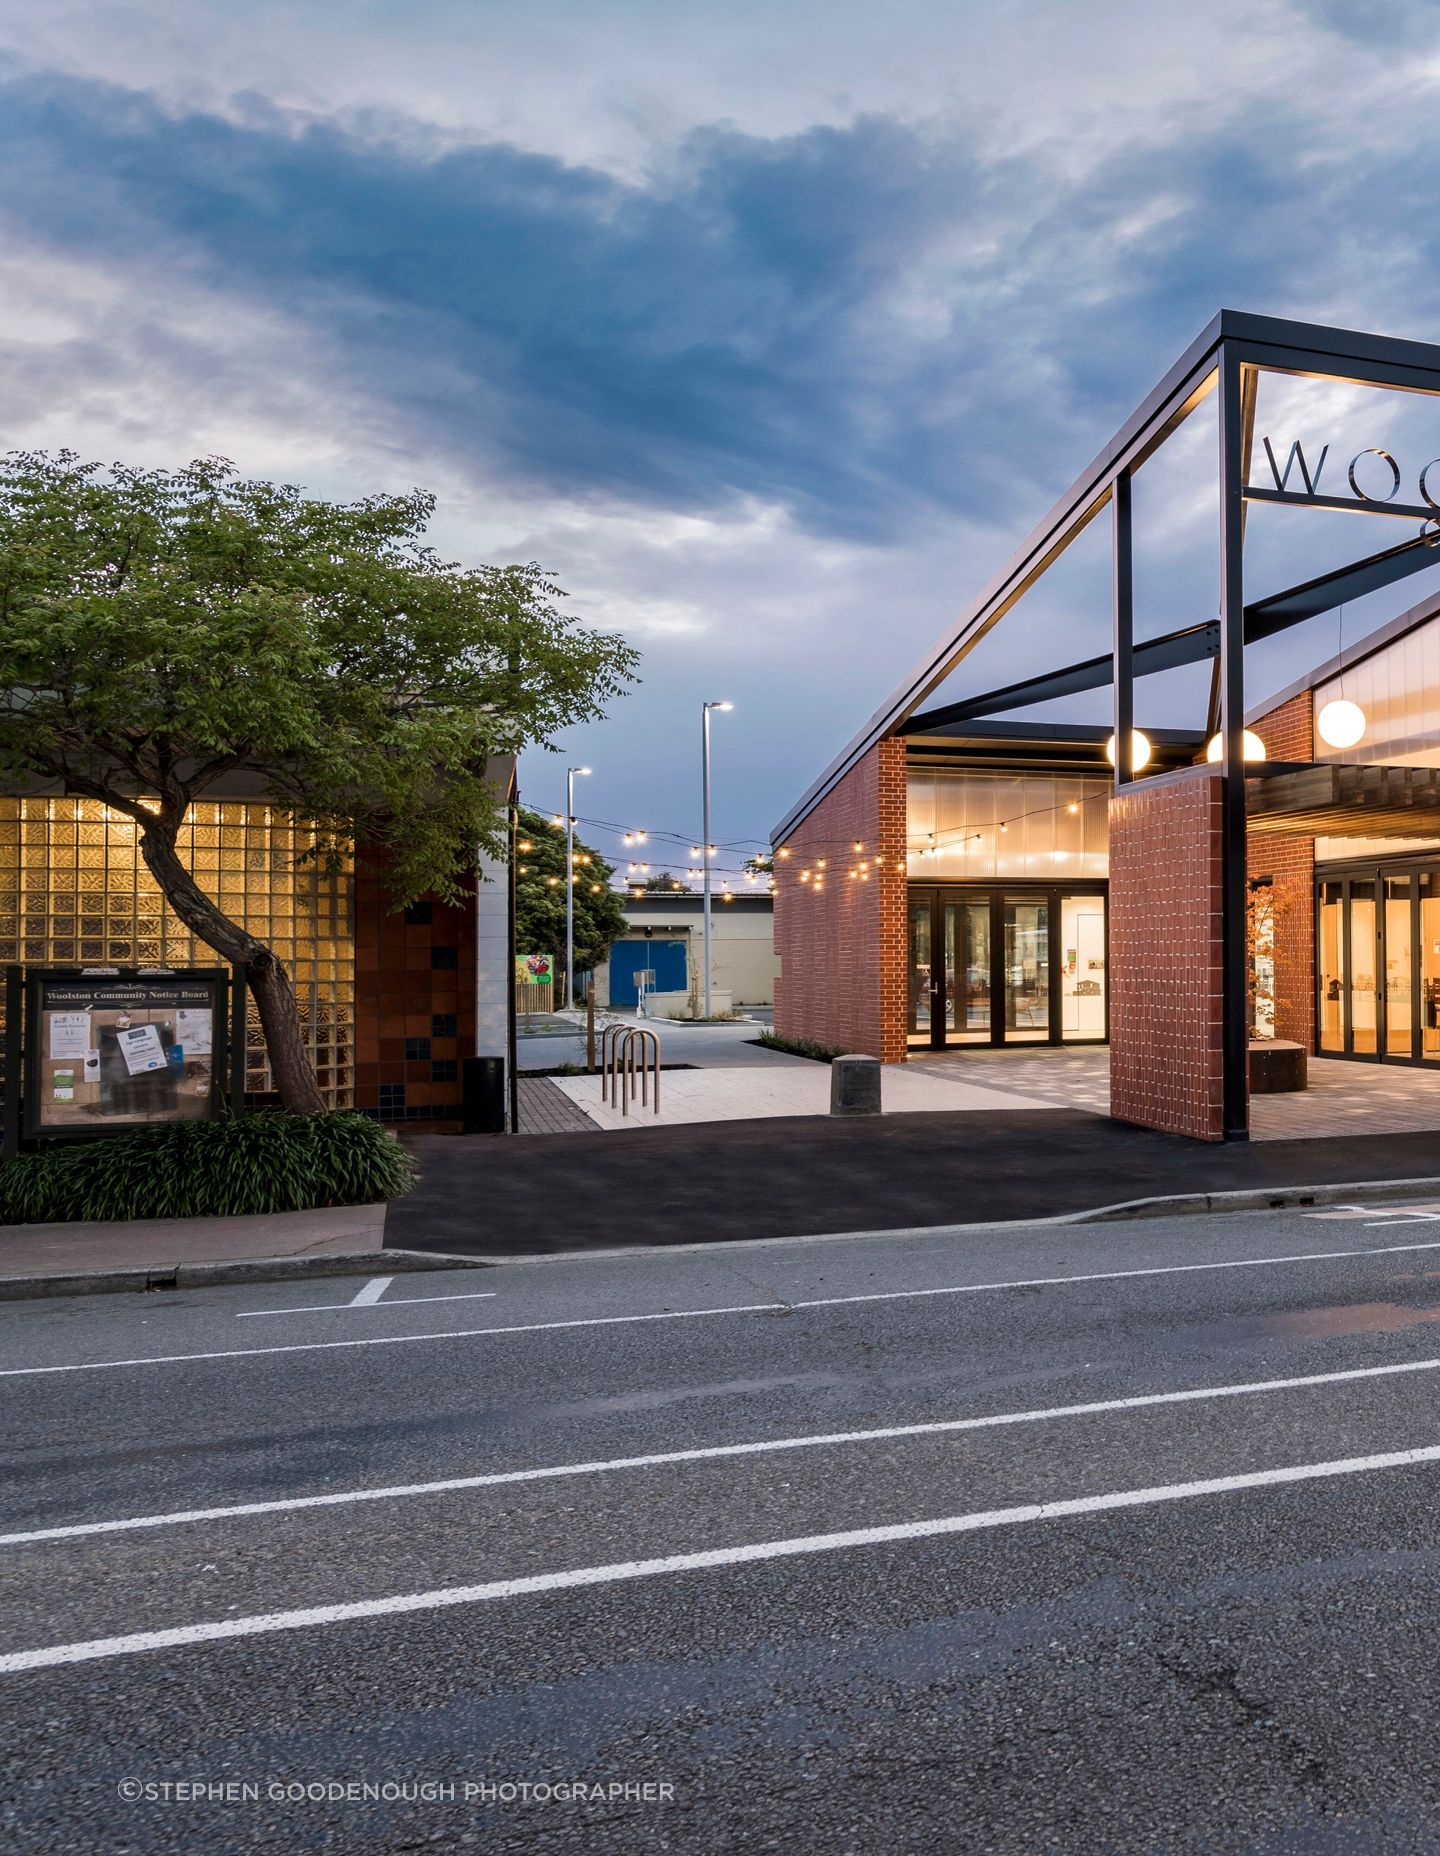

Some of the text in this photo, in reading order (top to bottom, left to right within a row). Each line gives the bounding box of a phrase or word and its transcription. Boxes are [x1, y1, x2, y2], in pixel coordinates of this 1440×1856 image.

[47, 990, 209, 1001] Woolston Community Notice Board
